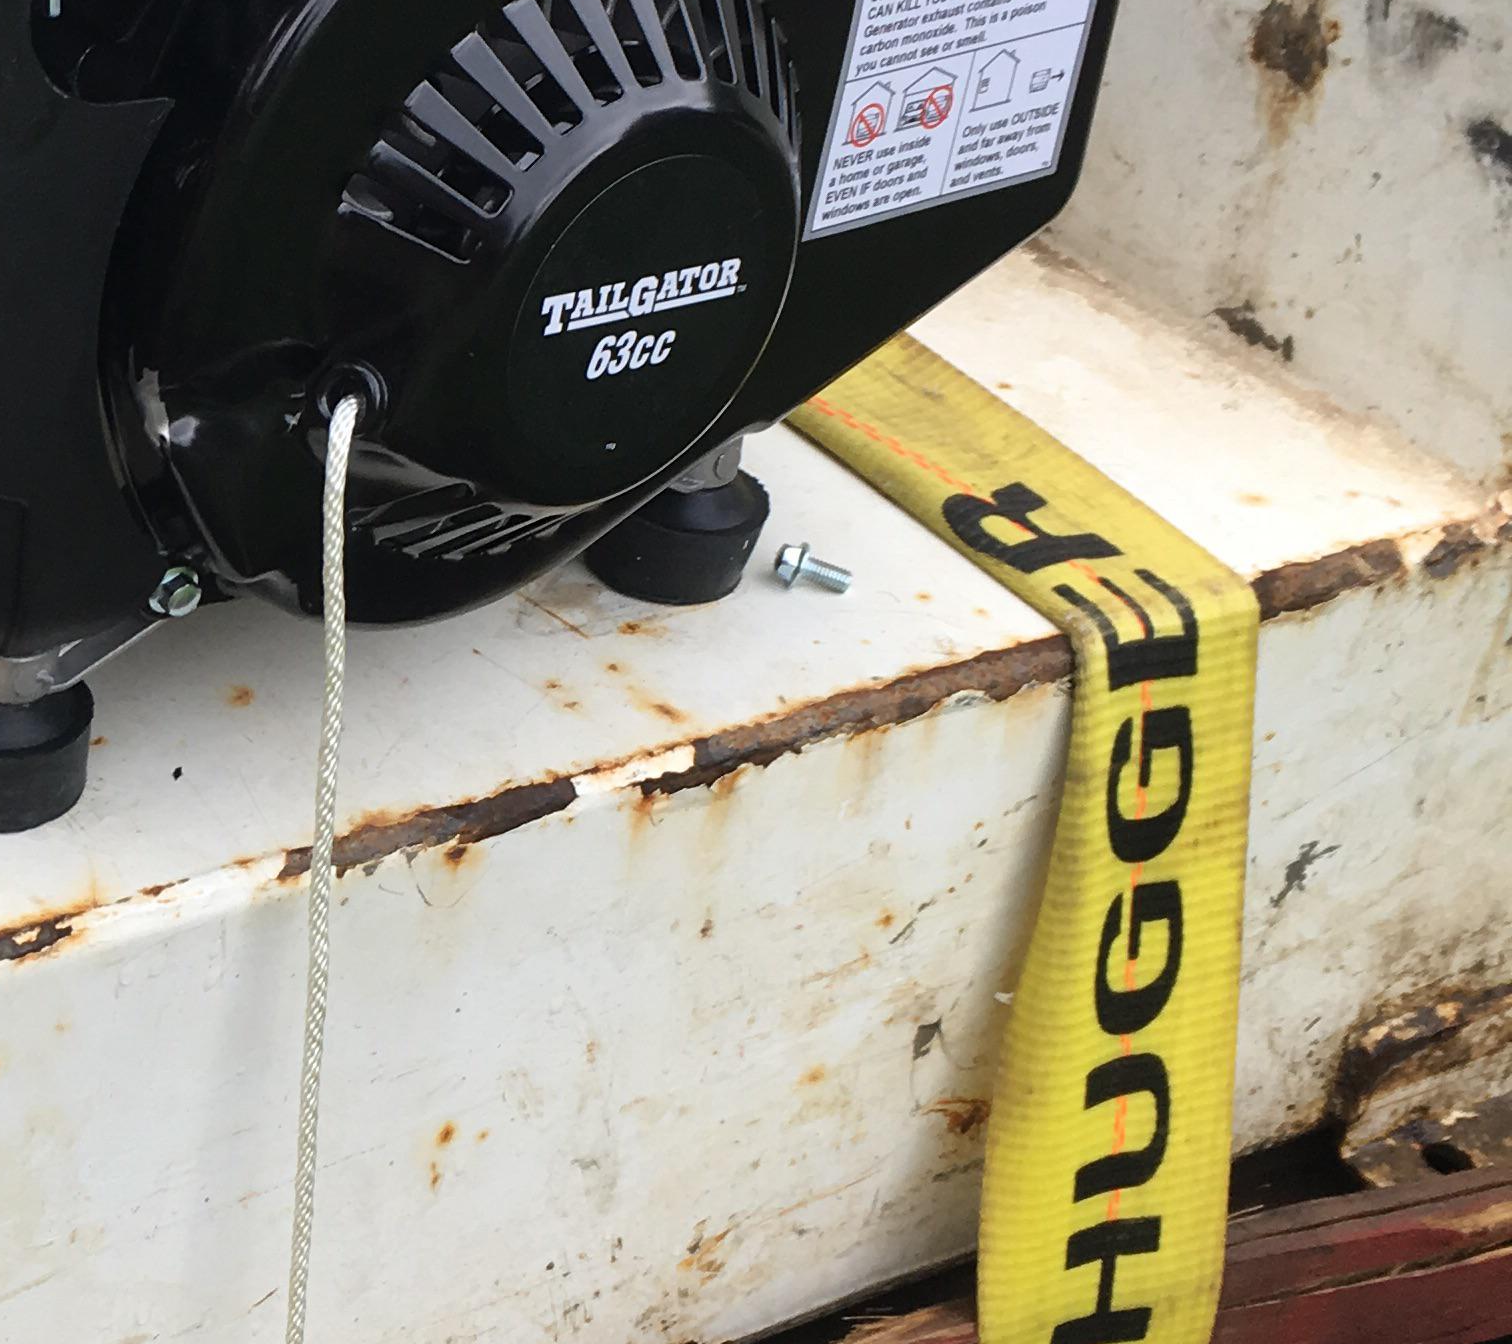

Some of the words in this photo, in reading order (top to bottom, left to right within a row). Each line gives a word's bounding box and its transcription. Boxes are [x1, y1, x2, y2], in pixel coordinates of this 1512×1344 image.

[859, 37, 899, 56] carbon
[965, 15, 987, 29] This
[988, 12, 999, 23] is
[1000, 10, 1008, 21] a
[1009, 1, 1047, 21] poison
[863, 15, 920, 38] Generator
[921, 3, 965, 24] exhaust
[867, 3, 893, 20] CAN
[854, 60, 877, 76] you
[879, 48, 918, 68] cannot
[919, 44, 939, 58] see
[941, 40, 955, 52] or
[961, 123, 987, 138] Only
[989, 118, 1008, 131] use
[1011, 102, 1060, 125] OUTSIDE
[832, 149, 873, 170] NEVER
[875, 146, 896, 159] use
[897, 135, 931, 153] inside
[957, 139, 979, 155] and
[980, 136, 996, 148] far
[996, 129, 1024, 144] away
[1026, 122, 1051, 137] from
[824, 186, 857, 204] EVEN
[859, 180, 872, 195] IF
[872, 174, 905, 191] doors
[906, 166, 928, 182] and
[828, 177, 836, 187] a
[838, 168, 870, 185] home
[872, 163, 885, 176] or
[949, 172, 971, 188] and
[821, 199, 870, 220] windows
[872, 194, 890, 207] are
[541, 258, 741, 336] TAILGATOR
[586, 330, 676, 380] 63cc
